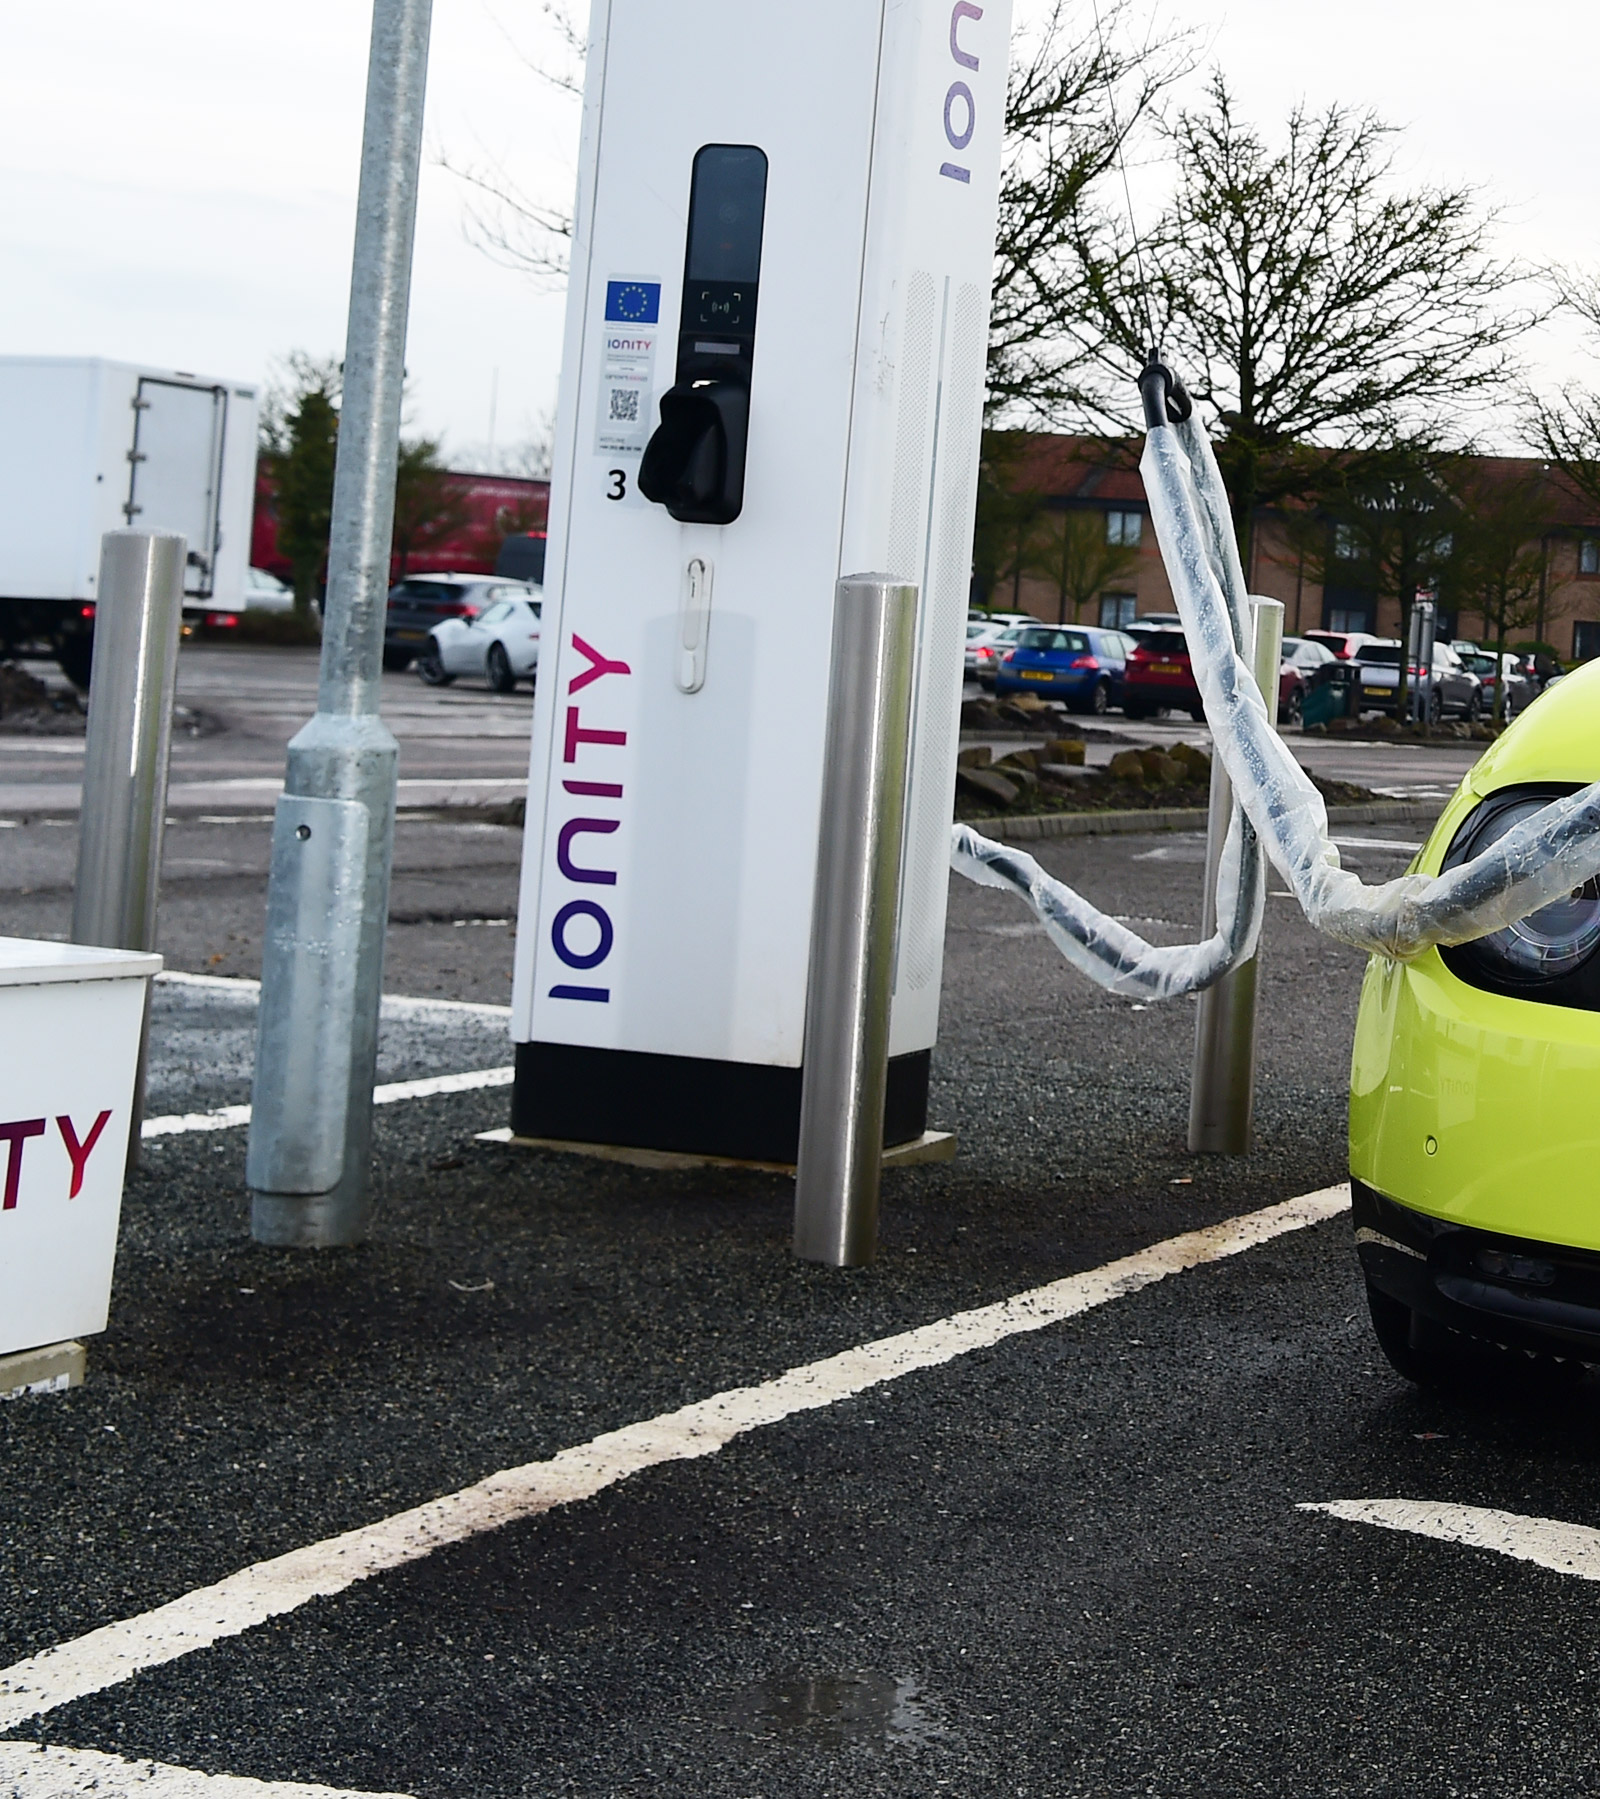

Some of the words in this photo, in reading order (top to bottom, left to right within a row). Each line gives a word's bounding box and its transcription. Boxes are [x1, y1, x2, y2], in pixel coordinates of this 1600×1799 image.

[607, 339, 652, 351] IONITY
[606, 469, 627, 501] 3
[547, 632, 632, 1004] IONITY
[0, 1109, 113, 1210] TY
